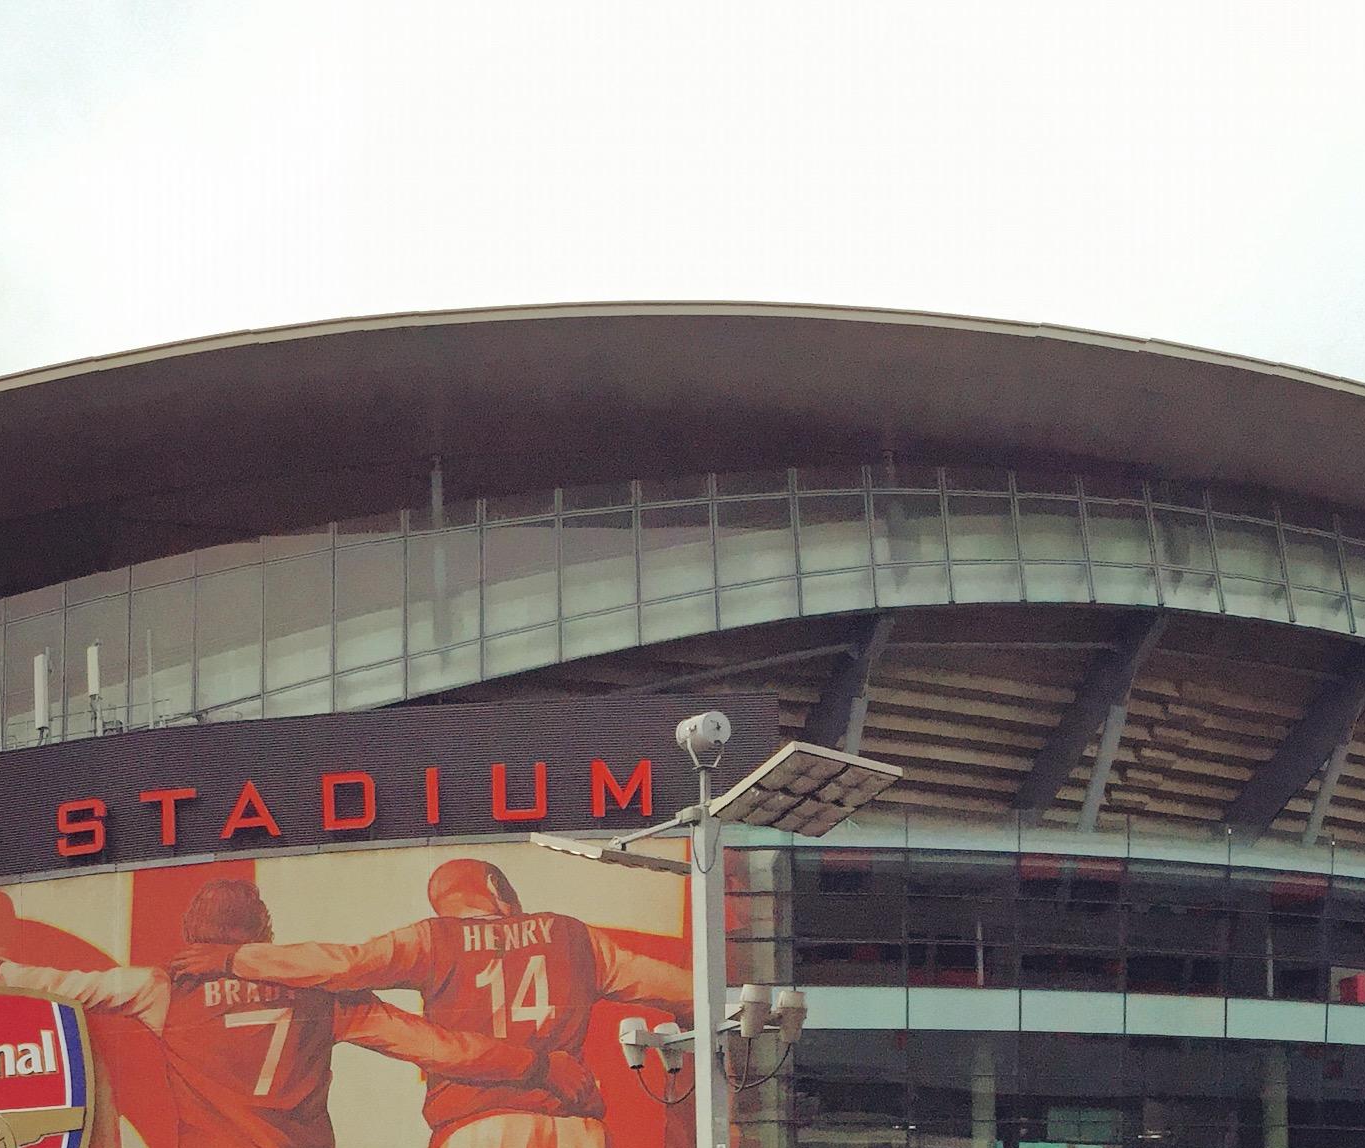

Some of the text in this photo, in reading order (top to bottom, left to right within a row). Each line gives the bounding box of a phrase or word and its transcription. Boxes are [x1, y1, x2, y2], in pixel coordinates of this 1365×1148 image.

[57, 758, 653, 857] STADIUM
[463, 918, 554, 952] HENRY
[204, 977, 295, 1007] BRAD
[476, 955, 556, 1039] 14
[224, 1007, 293, 1096] 7
